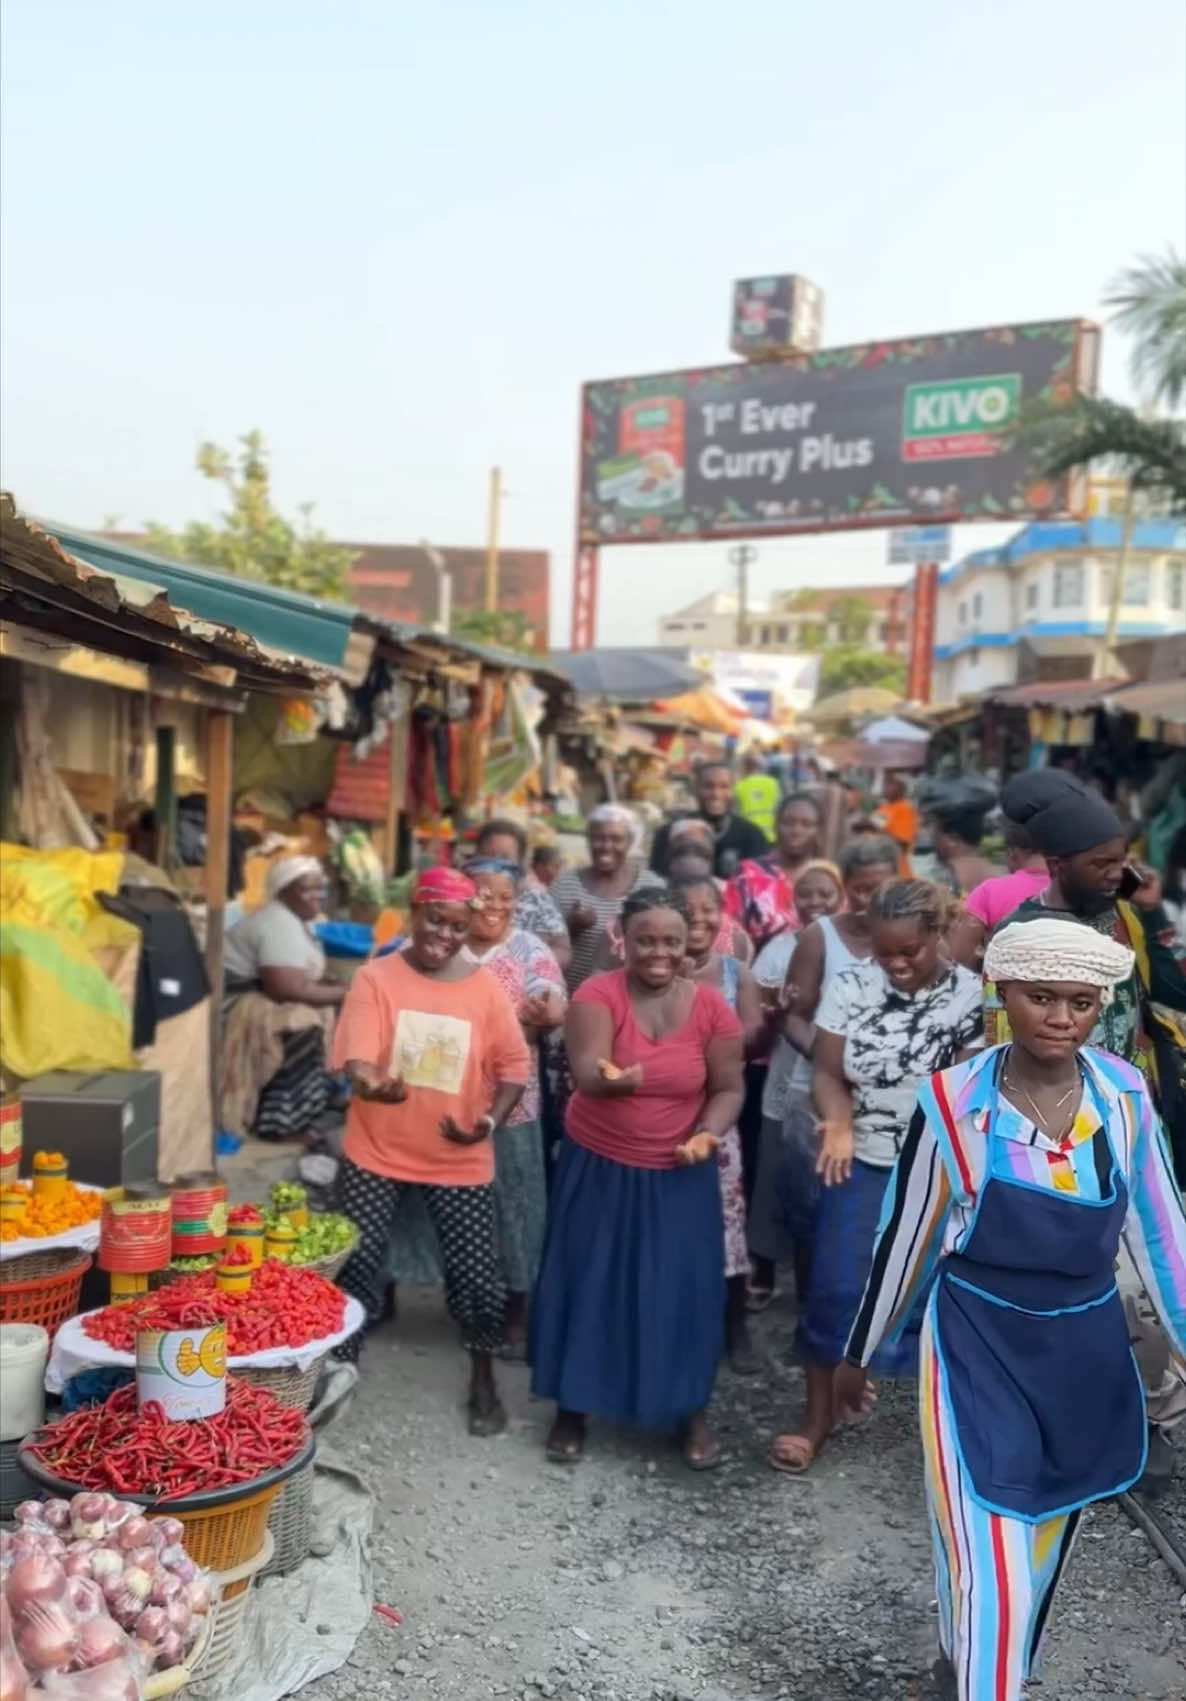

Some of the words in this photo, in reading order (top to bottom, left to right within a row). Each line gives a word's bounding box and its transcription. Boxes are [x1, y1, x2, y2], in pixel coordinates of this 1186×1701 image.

[701, 403, 734, 436] 1st
[741, 398, 816, 434] Ever
[914, 387, 1008, 428] KIVO
[700, 445, 793, 484] Curry
[799, 434, 873, 473] Plus
